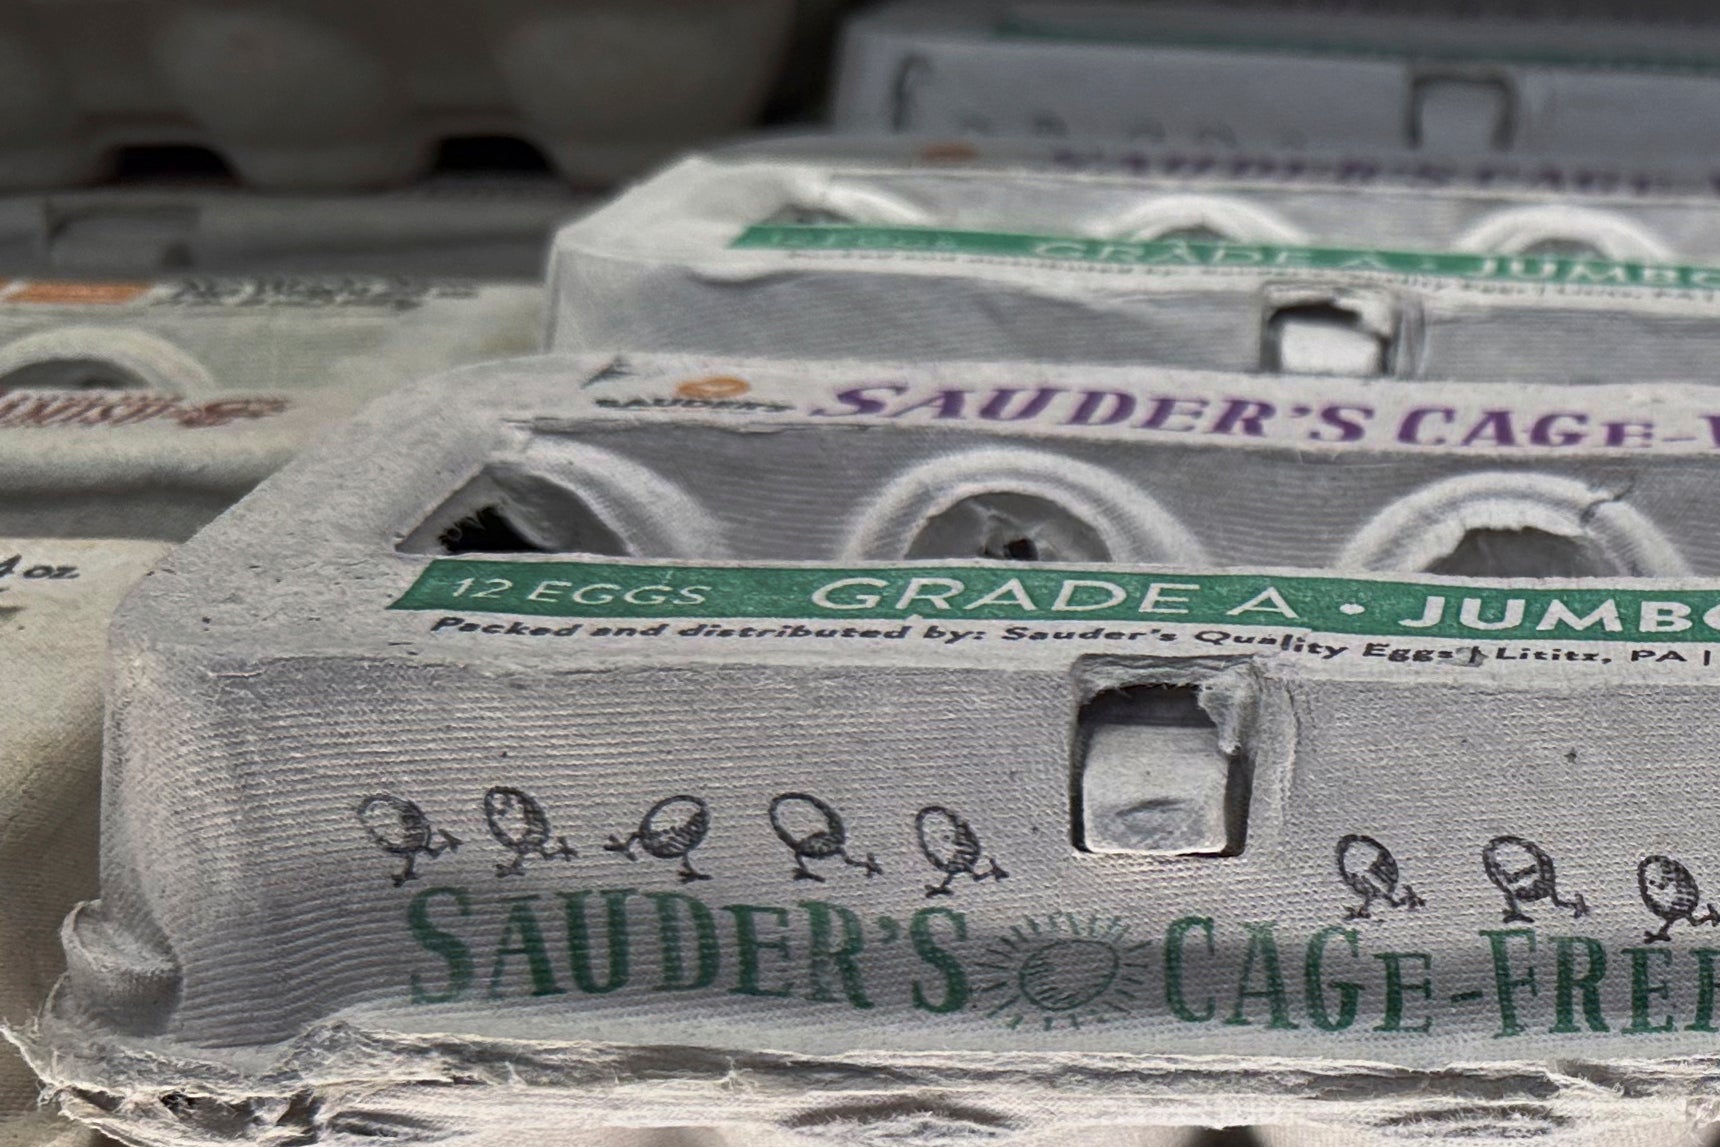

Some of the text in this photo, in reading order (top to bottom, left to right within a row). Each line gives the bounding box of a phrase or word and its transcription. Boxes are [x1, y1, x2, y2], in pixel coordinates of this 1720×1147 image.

[807, 380, 1376, 446] SAUDER'S
[451, 577, 713, 606] 12 EGGS
[811, 576, 1200, 615] GRADE
[1225, 585, 1300, 619] A
[430, 616, 582, 638] Packed
[589, 622, 673, 638] and
[678, 622, 912, 641] distributed
[922, 625, 987, 645] by:
[1001, 625, 1178, 644] Sauder's
[1195, 628, 1348, 660] Quality
[1362, 642, 1455, 663] Eggs
[1495, 646, 1613, 666] Lititz,
[1629, 648, 1688, 664] PA
[404, 885, 969, 1014] SAUDER'S
